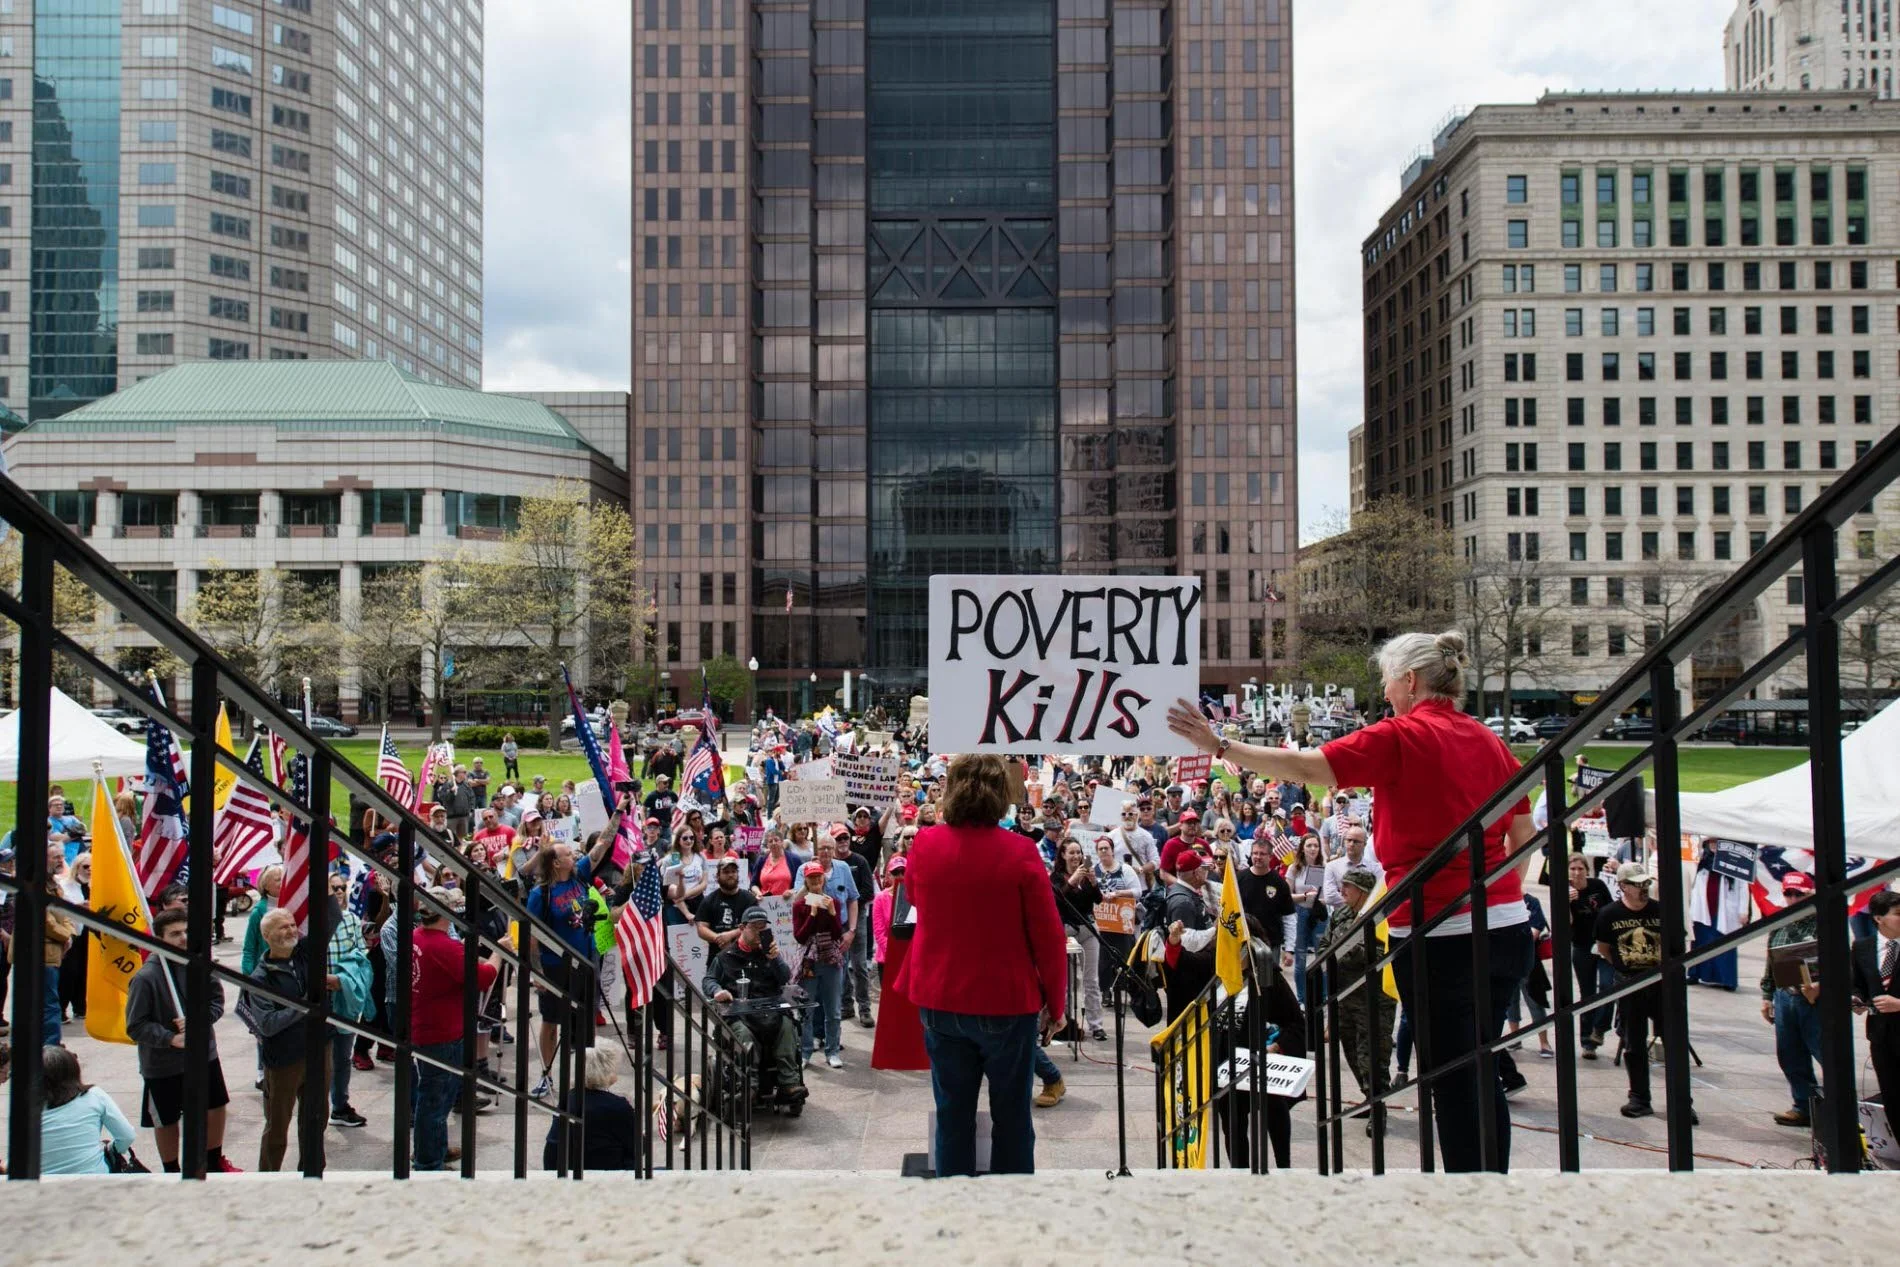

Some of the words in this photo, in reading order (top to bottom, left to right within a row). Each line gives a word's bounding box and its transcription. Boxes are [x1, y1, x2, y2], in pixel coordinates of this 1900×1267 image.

[945, 585, 1200, 665] POVERTY
[977, 668, 1151, 745] Kills
[838, 753, 859, 762] WHEN
[839, 761, 888, 773] INJUSTICE
[836, 769, 875, 781] BECOMES
[846, 781, 895, 791] SISTANCE
[873, 795, 895, 803] DUTY
[1289, 1064, 1303, 1074] Is
